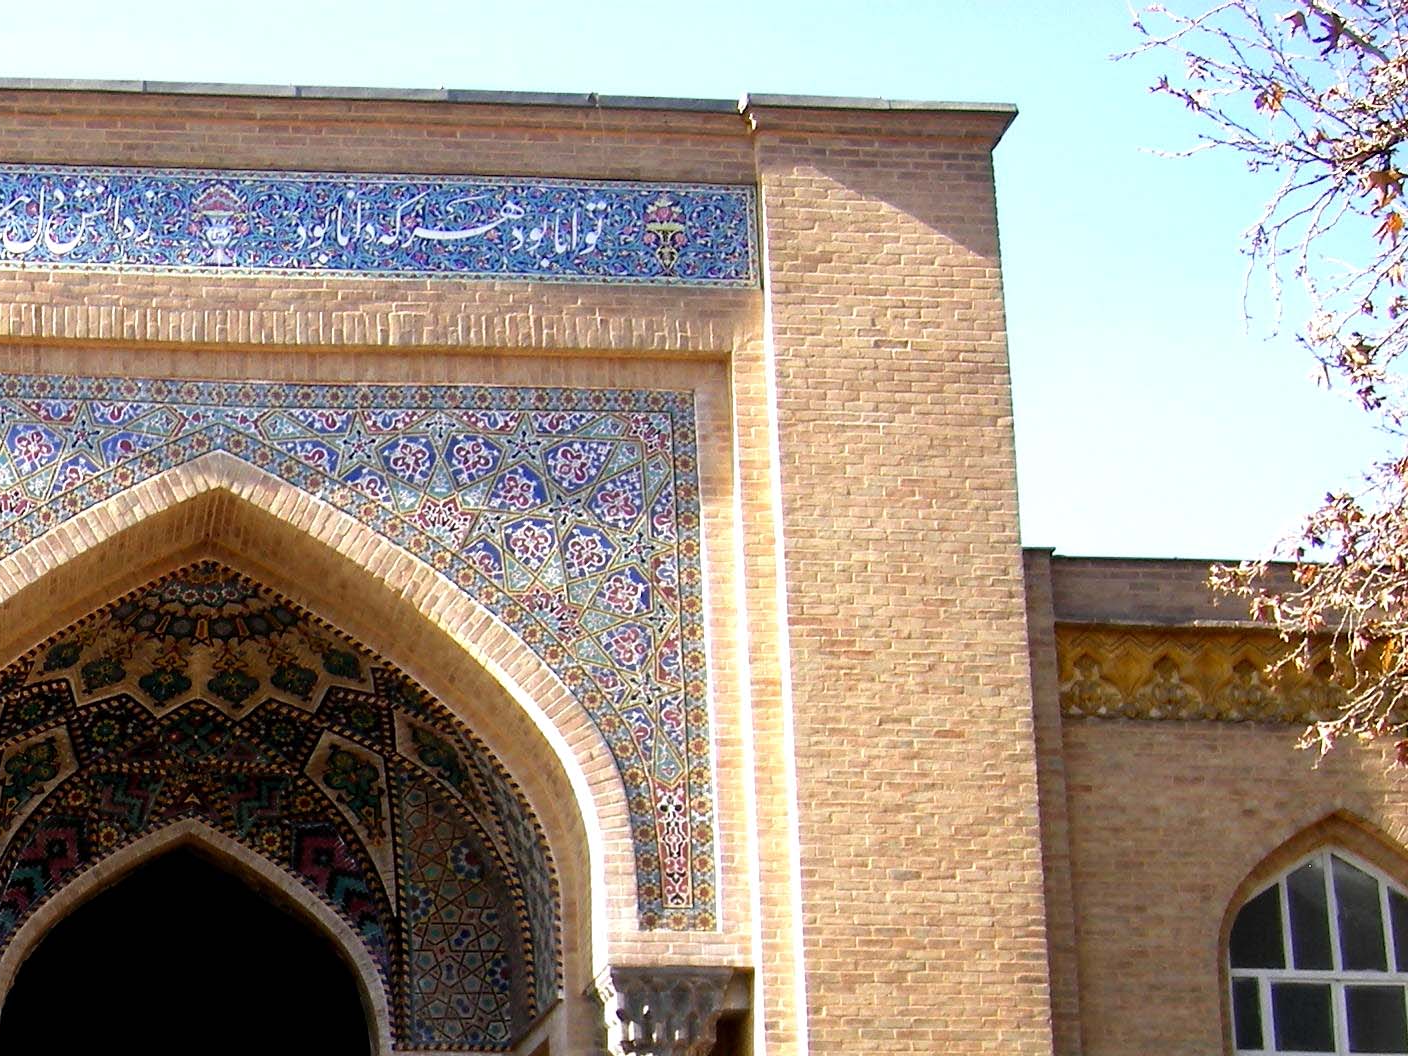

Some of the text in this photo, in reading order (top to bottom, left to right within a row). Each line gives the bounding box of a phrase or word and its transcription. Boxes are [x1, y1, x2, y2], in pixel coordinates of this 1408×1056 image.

[292, 207, 333, 264] بود
[337, 191, 376, 247] دانا
[510, 213, 550, 267] بود
[554, 200, 606, 255] توانا
